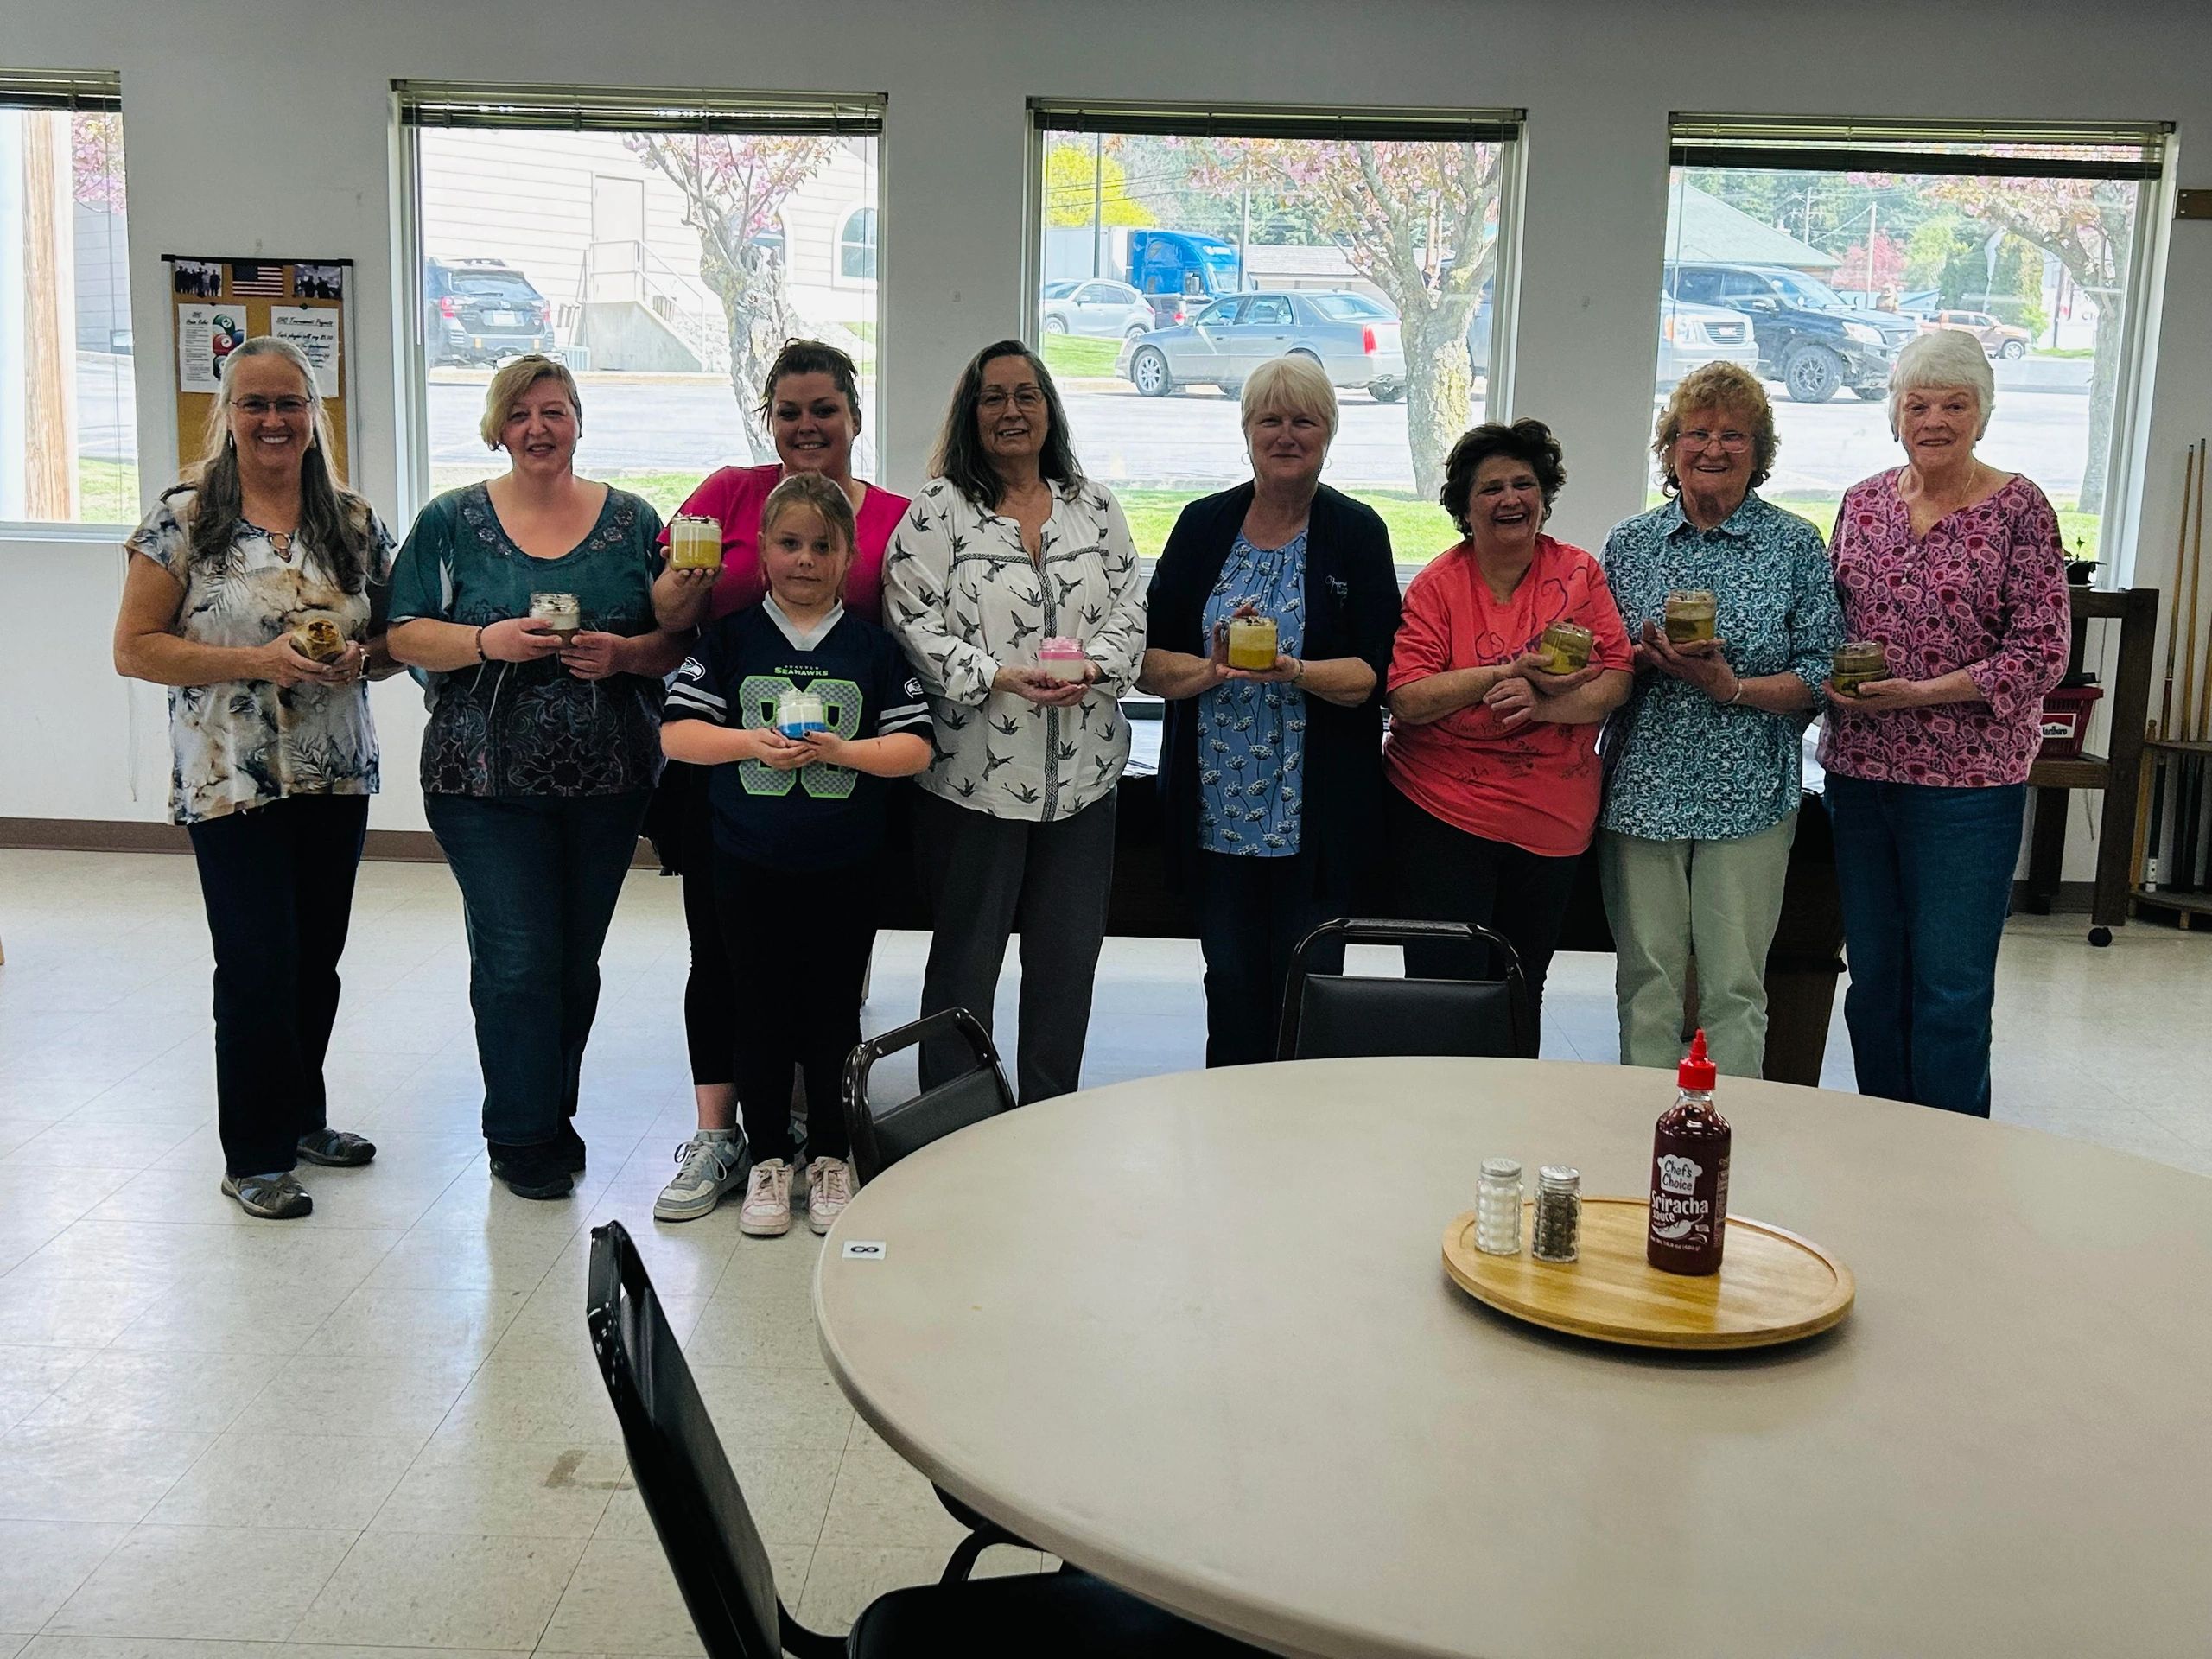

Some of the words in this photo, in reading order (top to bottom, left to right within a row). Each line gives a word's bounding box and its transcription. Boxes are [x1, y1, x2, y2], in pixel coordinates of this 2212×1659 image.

[774, 667, 829, 676] SEAHAWKS
[1664, 1160, 1693, 1178] Chef's
[1662, 1173, 1693, 1191] Choice
[1651, 1190, 1709, 1215] Sriracha
